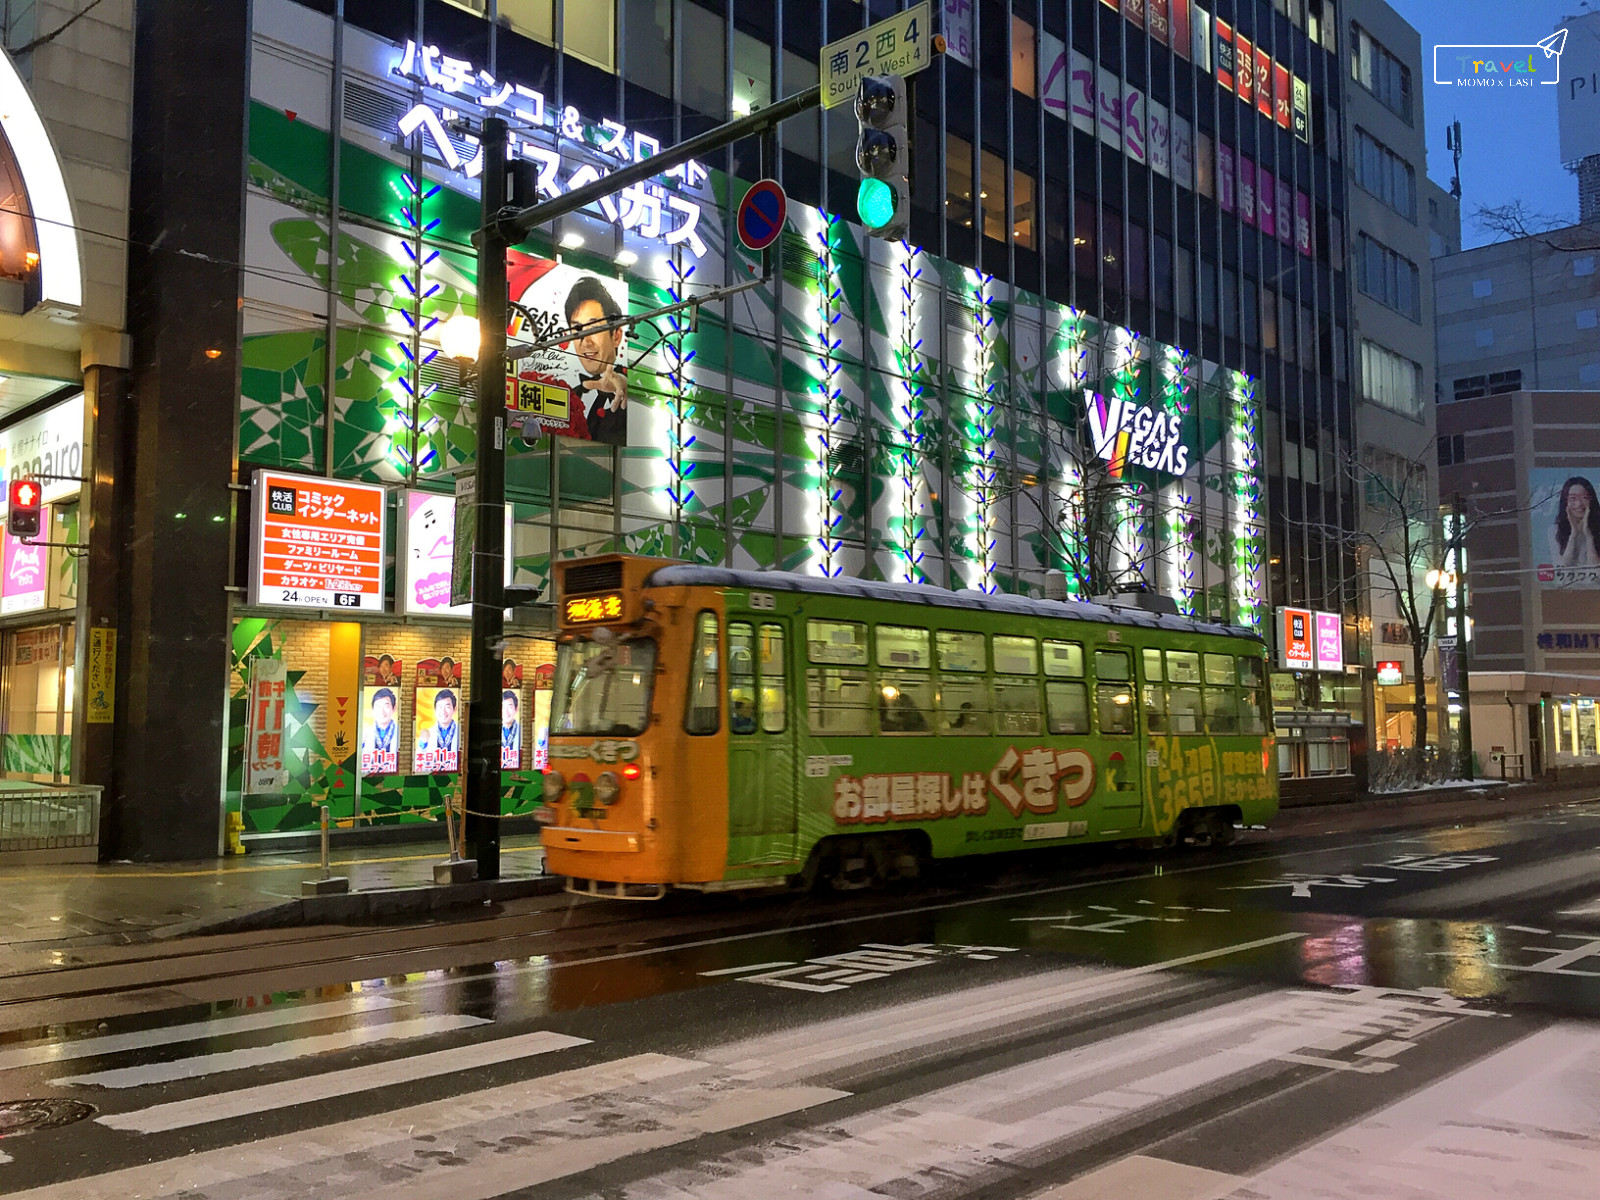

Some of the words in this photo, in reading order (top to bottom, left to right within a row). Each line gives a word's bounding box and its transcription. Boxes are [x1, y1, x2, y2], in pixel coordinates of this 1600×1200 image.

[829, 17, 920, 79] 南2西4
[880, 51, 911, 74] West
[913, 47, 921, 60] 4
[399, 39, 544, 126] パチンコ
[560, 104, 585, 143] &
[271, 492, 294, 503] 快活
[272, 502, 293, 512] CLUB
[297, 489, 345, 508] コミック
[297, 505, 379, 526] インターネット
[287, 543, 359, 560] ファミリールーム
[283, 558, 362, 577] ダーツ・ビリヤード
[339, 593, 356, 606] 6F
[90, 630, 102, 690] ご通行ください
[362, 749, 395, 764] 日11時
[416, 749, 457, 763] 本日11時
[416, 761, 457, 773] オープン!!
[833, 772, 989, 821] お部屋探しは
[990, 746, 1096, 817] くきつ
